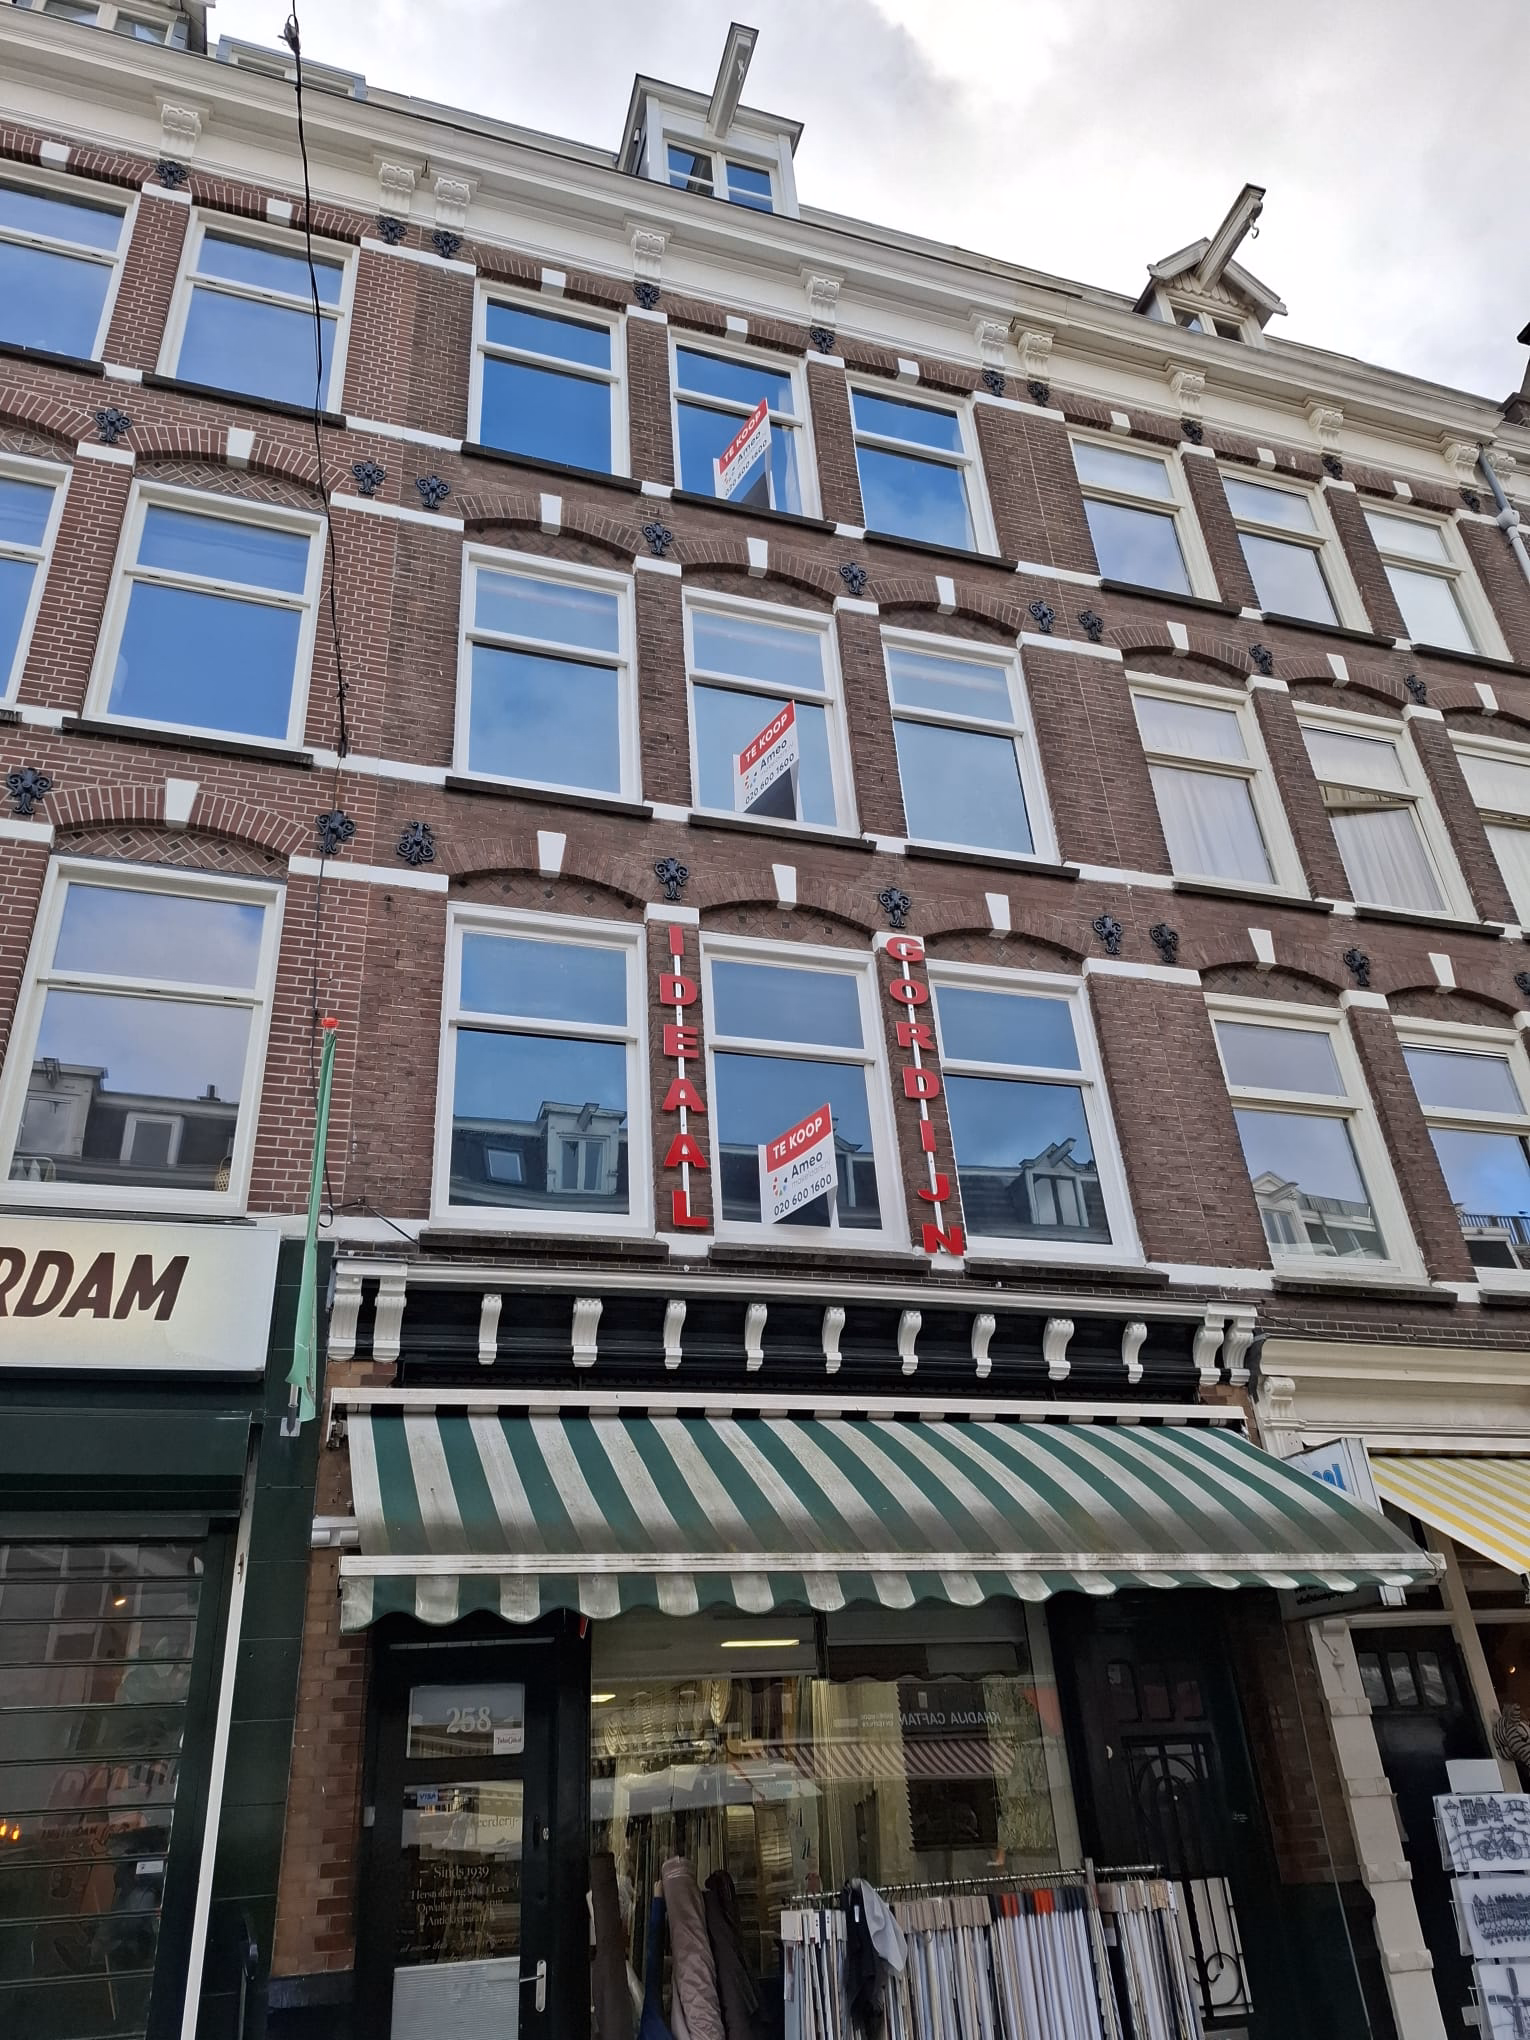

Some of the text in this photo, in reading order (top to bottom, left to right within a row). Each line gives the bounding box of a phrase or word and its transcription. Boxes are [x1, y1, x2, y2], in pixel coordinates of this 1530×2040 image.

[723, 410, 761, 463] TE KOOP
[745, 744, 757, 763] TE
[759, 713, 788, 749] KOOP
[760, 739, 788, 770] Ameo
[745, 788, 759, 805] 020
[760, 772, 774, 790] 600
[776, 752, 795, 774] 1600
[659, 925, 710, 1228] IDEAAL
[886, 936, 966, 1257] GORDIJN
[773, 1116, 823, 1161] TE KOOP
[791, 1151, 823, 1179] Ameo
[774, 1173, 832, 1216] 020 600 1600
[446, 1706, 492, 1734] 258
[466, 1866, 490, 1880] 1939
